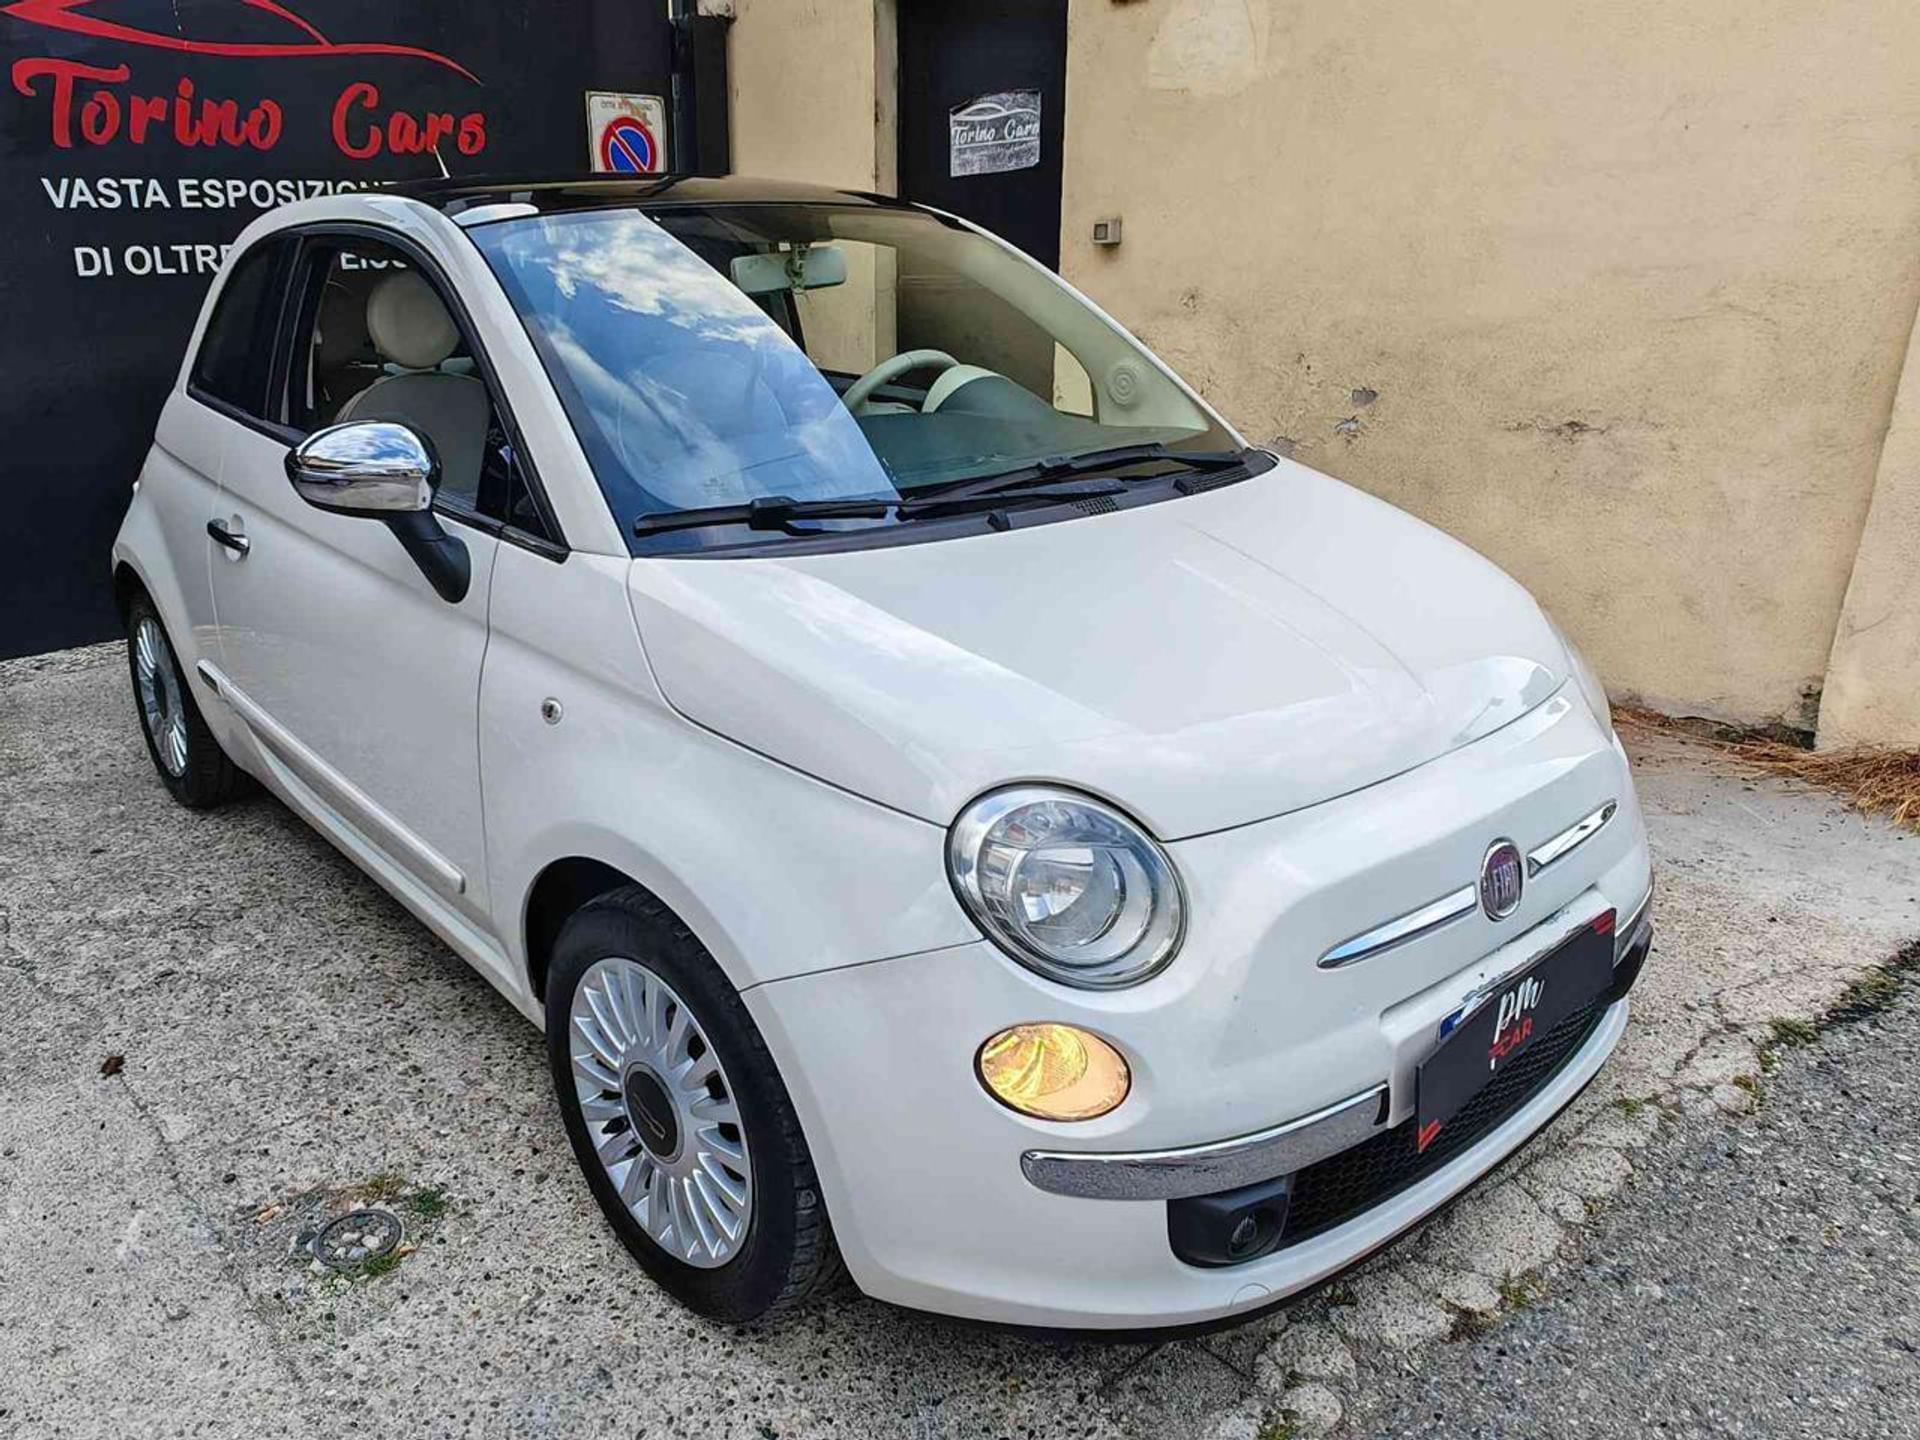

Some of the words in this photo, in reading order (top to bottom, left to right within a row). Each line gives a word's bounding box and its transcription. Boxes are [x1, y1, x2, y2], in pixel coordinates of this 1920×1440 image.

[12, 58, 282, 149] Torino
[332, 82, 487, 159] Cars
[41, 178, 170, 209] VASTA
[178, 178, 397, 208] ESPOSIZI
[73, 245, 114, 277] DI
